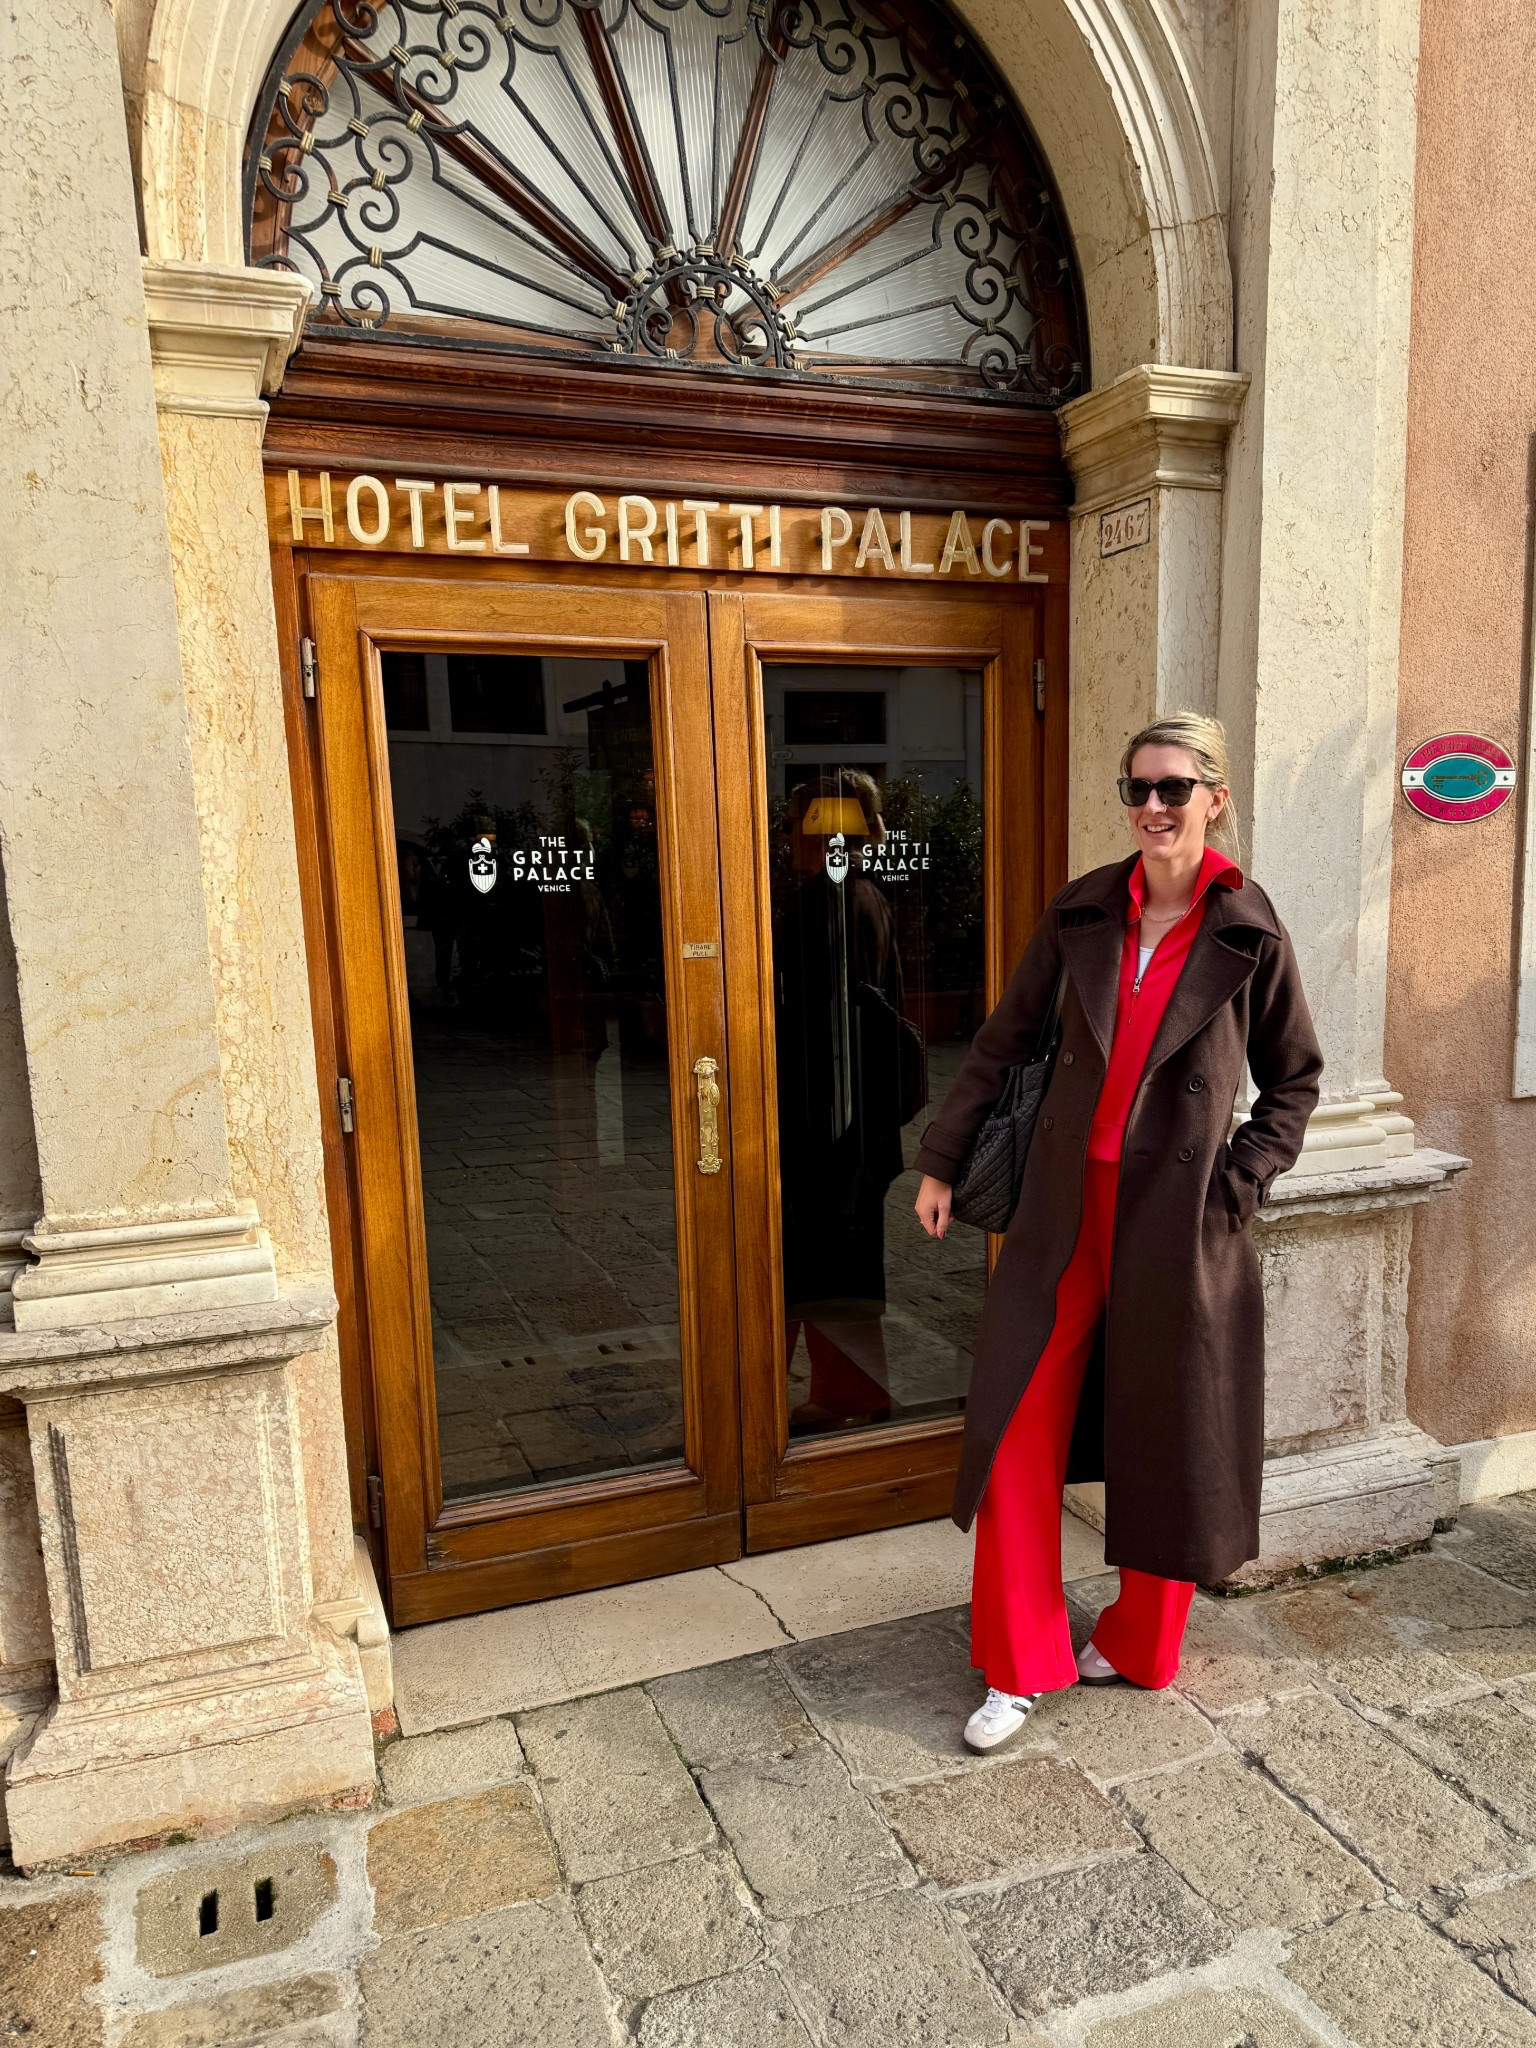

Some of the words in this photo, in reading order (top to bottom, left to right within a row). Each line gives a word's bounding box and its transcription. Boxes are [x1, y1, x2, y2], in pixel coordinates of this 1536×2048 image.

[287, 469, 530, 554] HOTEL
[564, 490, 782, 569] GRITTI
[820, 506, 1051, 584] PALACE
[1104, 508, 1148, 549] 2467
[539, 836, 566, 848] THE
[885, 830, 907, 841] THE
[862, 843, 930, 857] GRITTI
[512, 850, 595, 865] GRITTI
[862, 857, 930, 872] PALACE
[513, 866, 595, 881] PALACE
[882, 874, 910, 882] VENICE
[537, 884, 571, 893] VENICE
